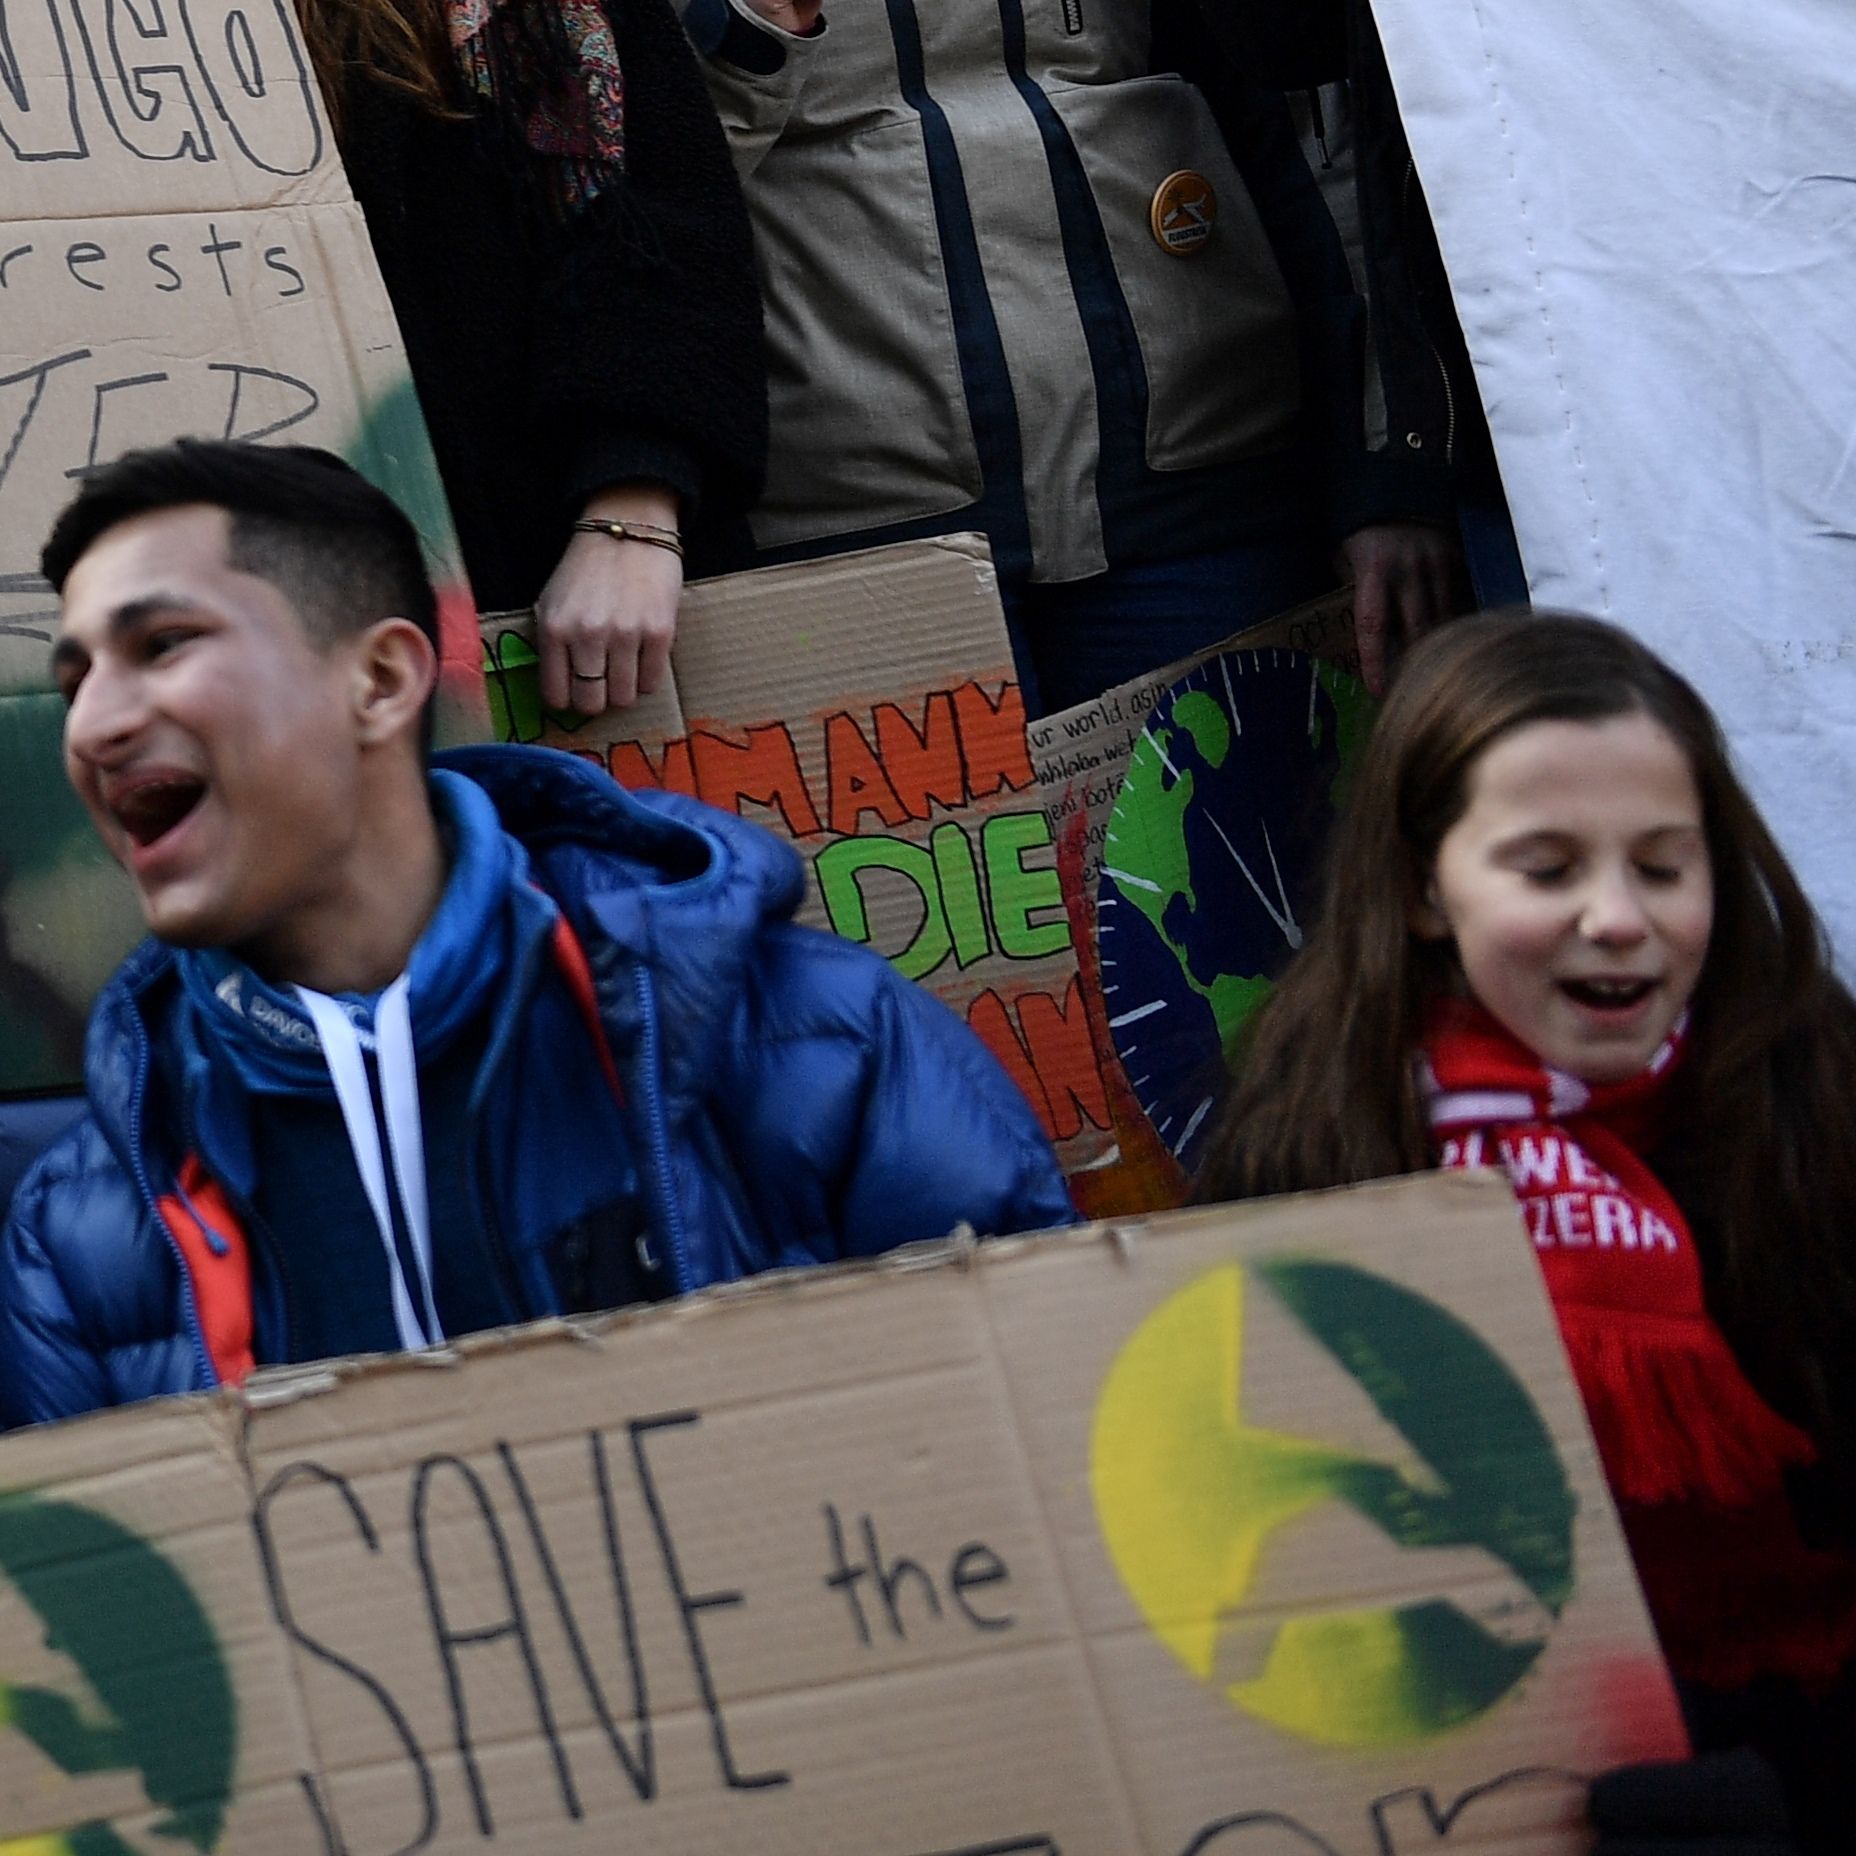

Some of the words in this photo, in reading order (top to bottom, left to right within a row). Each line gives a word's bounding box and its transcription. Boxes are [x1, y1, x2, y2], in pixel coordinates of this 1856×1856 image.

[815, 810, 1073, 981] DIE
[251, 1410, 792, 1856] SAVE
[824, 1500, 1015, 1648] the
